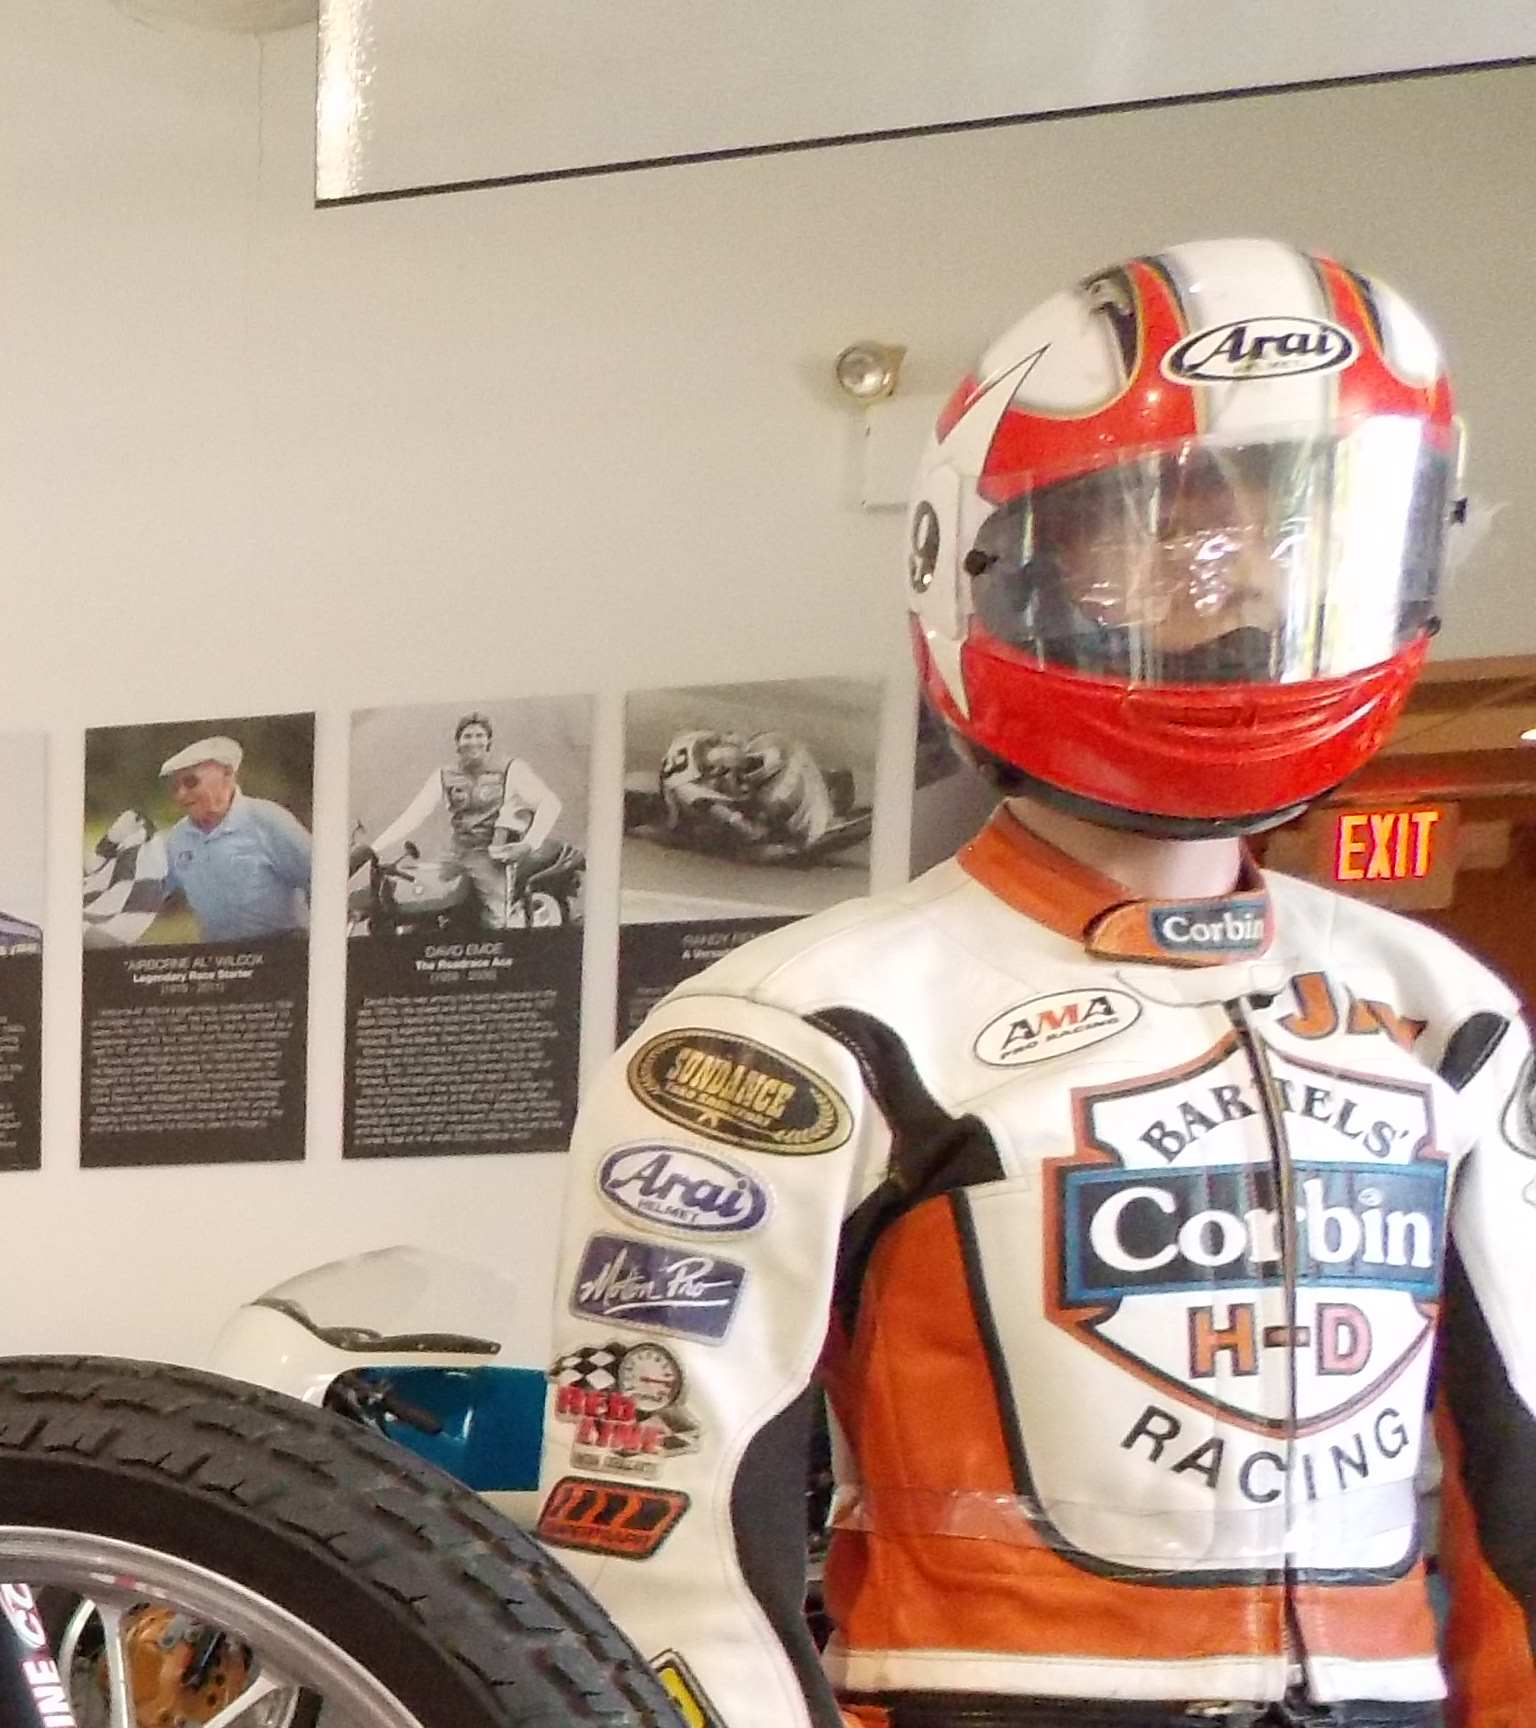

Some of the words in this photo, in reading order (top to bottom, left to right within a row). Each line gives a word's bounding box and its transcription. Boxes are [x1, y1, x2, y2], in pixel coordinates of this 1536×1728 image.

[1184, 324, 1334, 373] Arai
[909, 499, 941, 594] 9
[1336, 809, 1441, 881] EXIT
[1162, 911, 1265, 944] Corbin
[1000, 995, 1116, 1051] AMA
[664, 1046, 797, 1119] SUNDANCE
[608, 1152, 749, 1219] Arai
[637, 1198, 700, 1224] HELMET
[1088, 1176, 1434, 1272] Corbin
[1187, 1302, 1374, 1379] H-D
[1120, 1404, 1410, 1504] RACING
